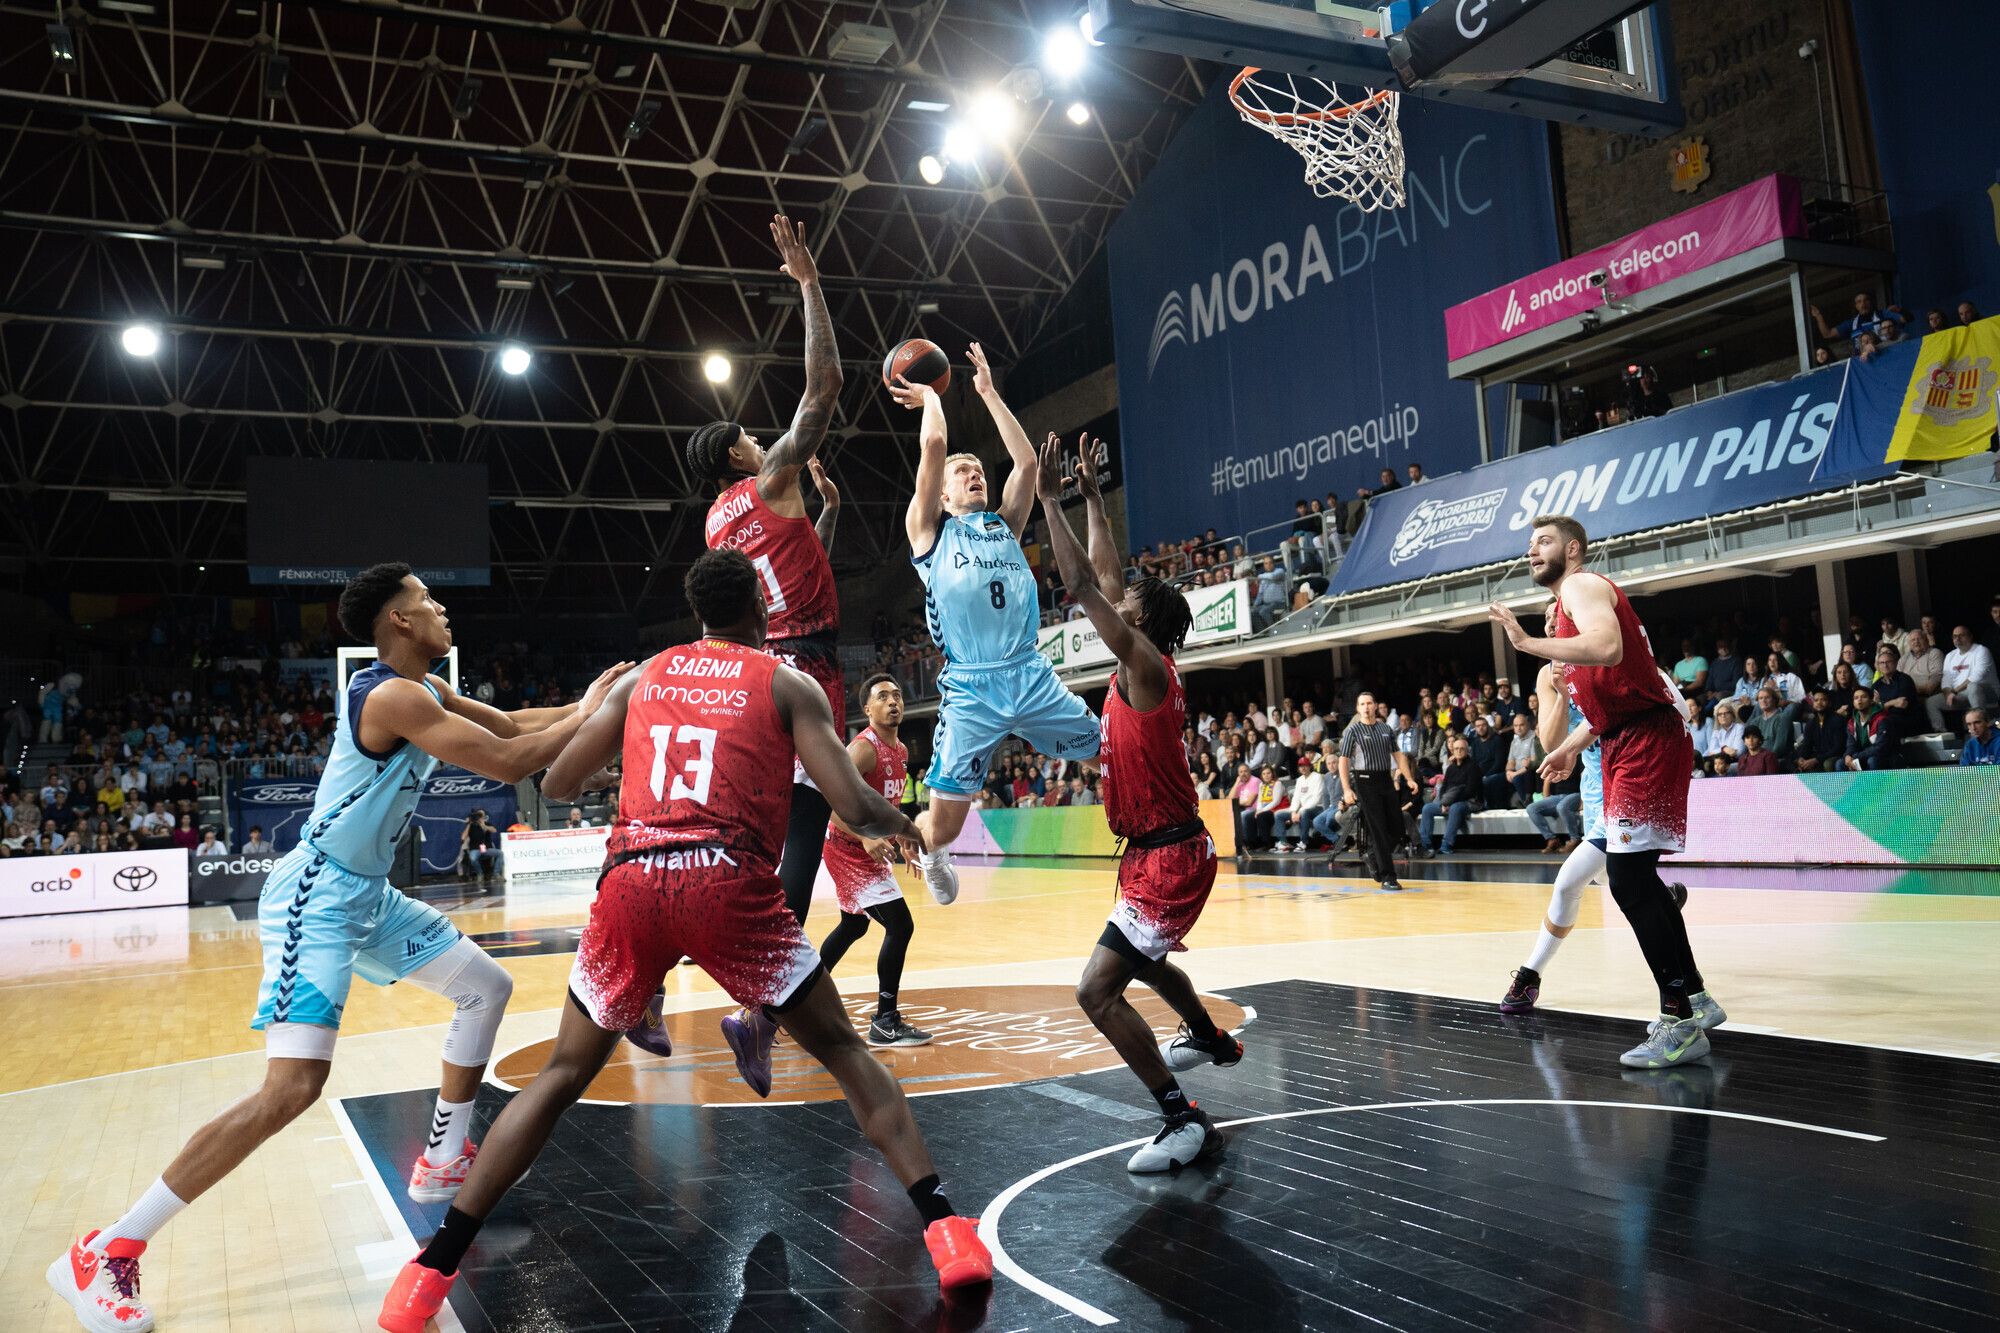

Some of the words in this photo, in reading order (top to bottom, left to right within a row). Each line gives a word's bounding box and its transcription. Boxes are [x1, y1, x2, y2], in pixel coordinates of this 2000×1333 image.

[1608, 230, 1700, 280] telecom
[1211, 402, 1419, 496] #femungranequip
[1508, 459, 1620, 532] SOM
[1616, 437, 1700, 506] UN
[1694, 393, 1838, 488] PAÍS
[1434, 493, 1501, 519] MORABANC
[1425, 507, 1494, 538] ANDORRA
[989, 581, 1006, 609] 8
[666, 655, 743, 679] SAGNIA
[643, 681, 748, 708] inmoovs
[710, 708, 744, 718] AVINENT
[649, 724, 718, 806] 13
[429, 777, 487, 795] Ford
[31, 876, 73, 893] acb
